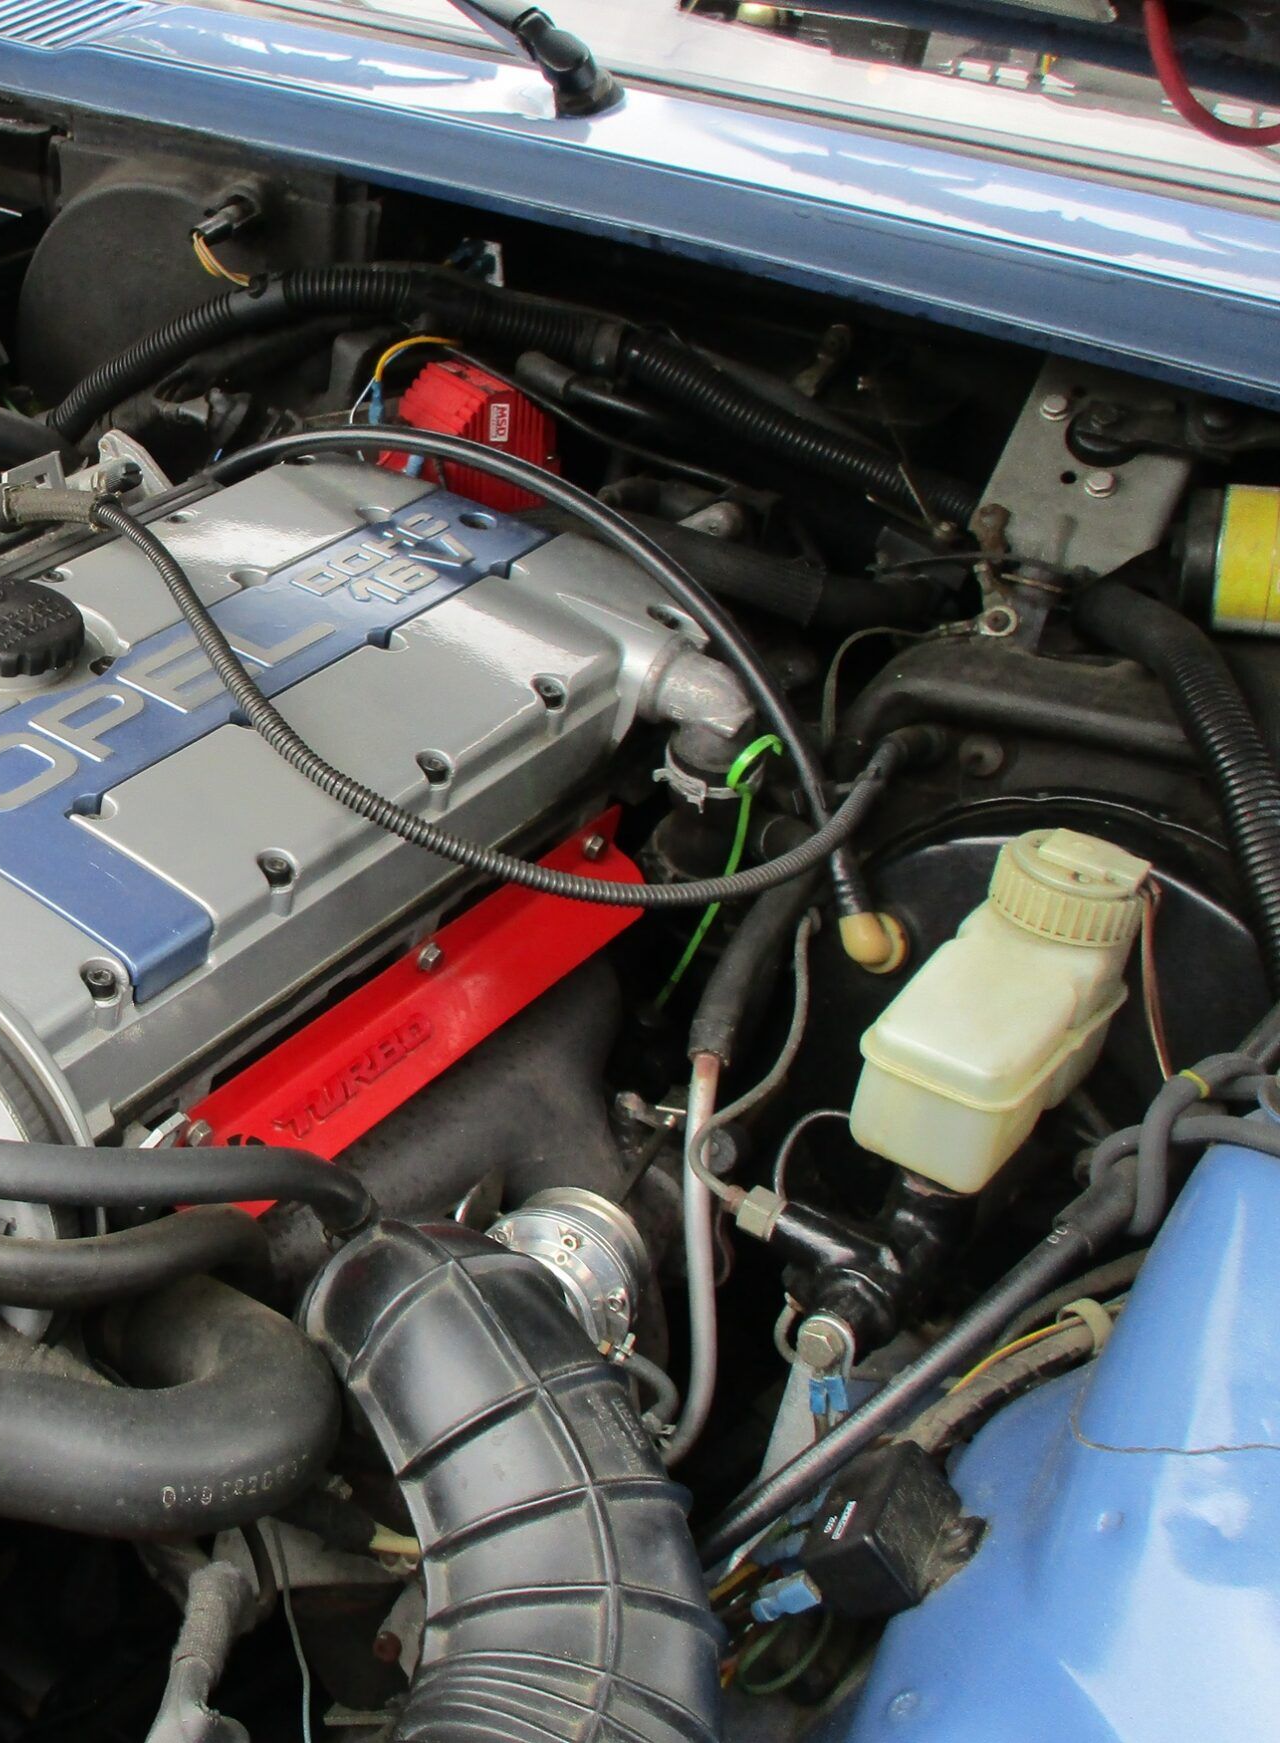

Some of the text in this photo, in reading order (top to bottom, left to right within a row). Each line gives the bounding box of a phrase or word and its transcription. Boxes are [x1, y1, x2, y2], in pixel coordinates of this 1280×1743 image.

[497, 405, 508, 437] MSD
[290, 512, 451, 598] DOHC
[348, 532, 477, 604] 16V
[271, 1012, 433, 1141] TURBO
